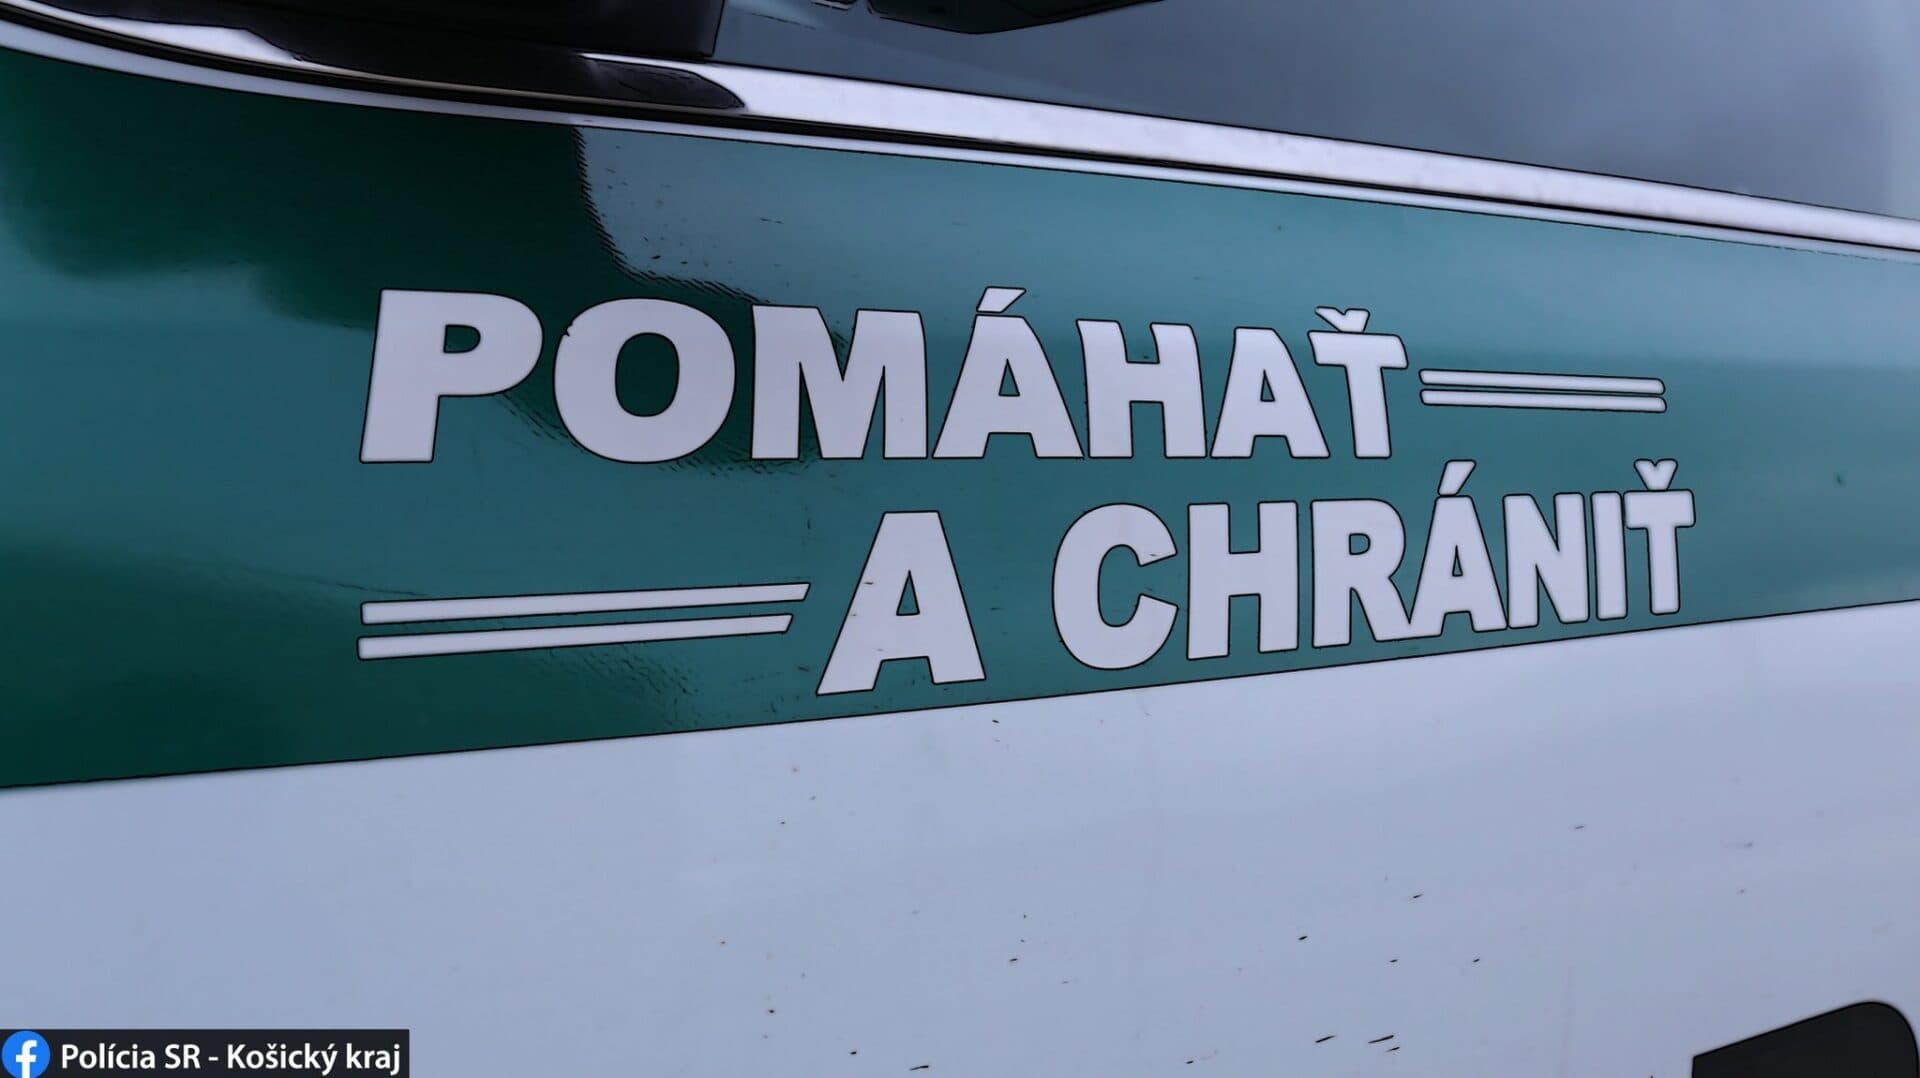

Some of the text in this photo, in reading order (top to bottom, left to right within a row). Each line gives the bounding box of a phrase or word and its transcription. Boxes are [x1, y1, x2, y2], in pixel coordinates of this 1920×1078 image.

[359, 286, 1409, 464] POMÁHAŤ
[815, 458, 1696, 696] A CHRÁNIŤ
